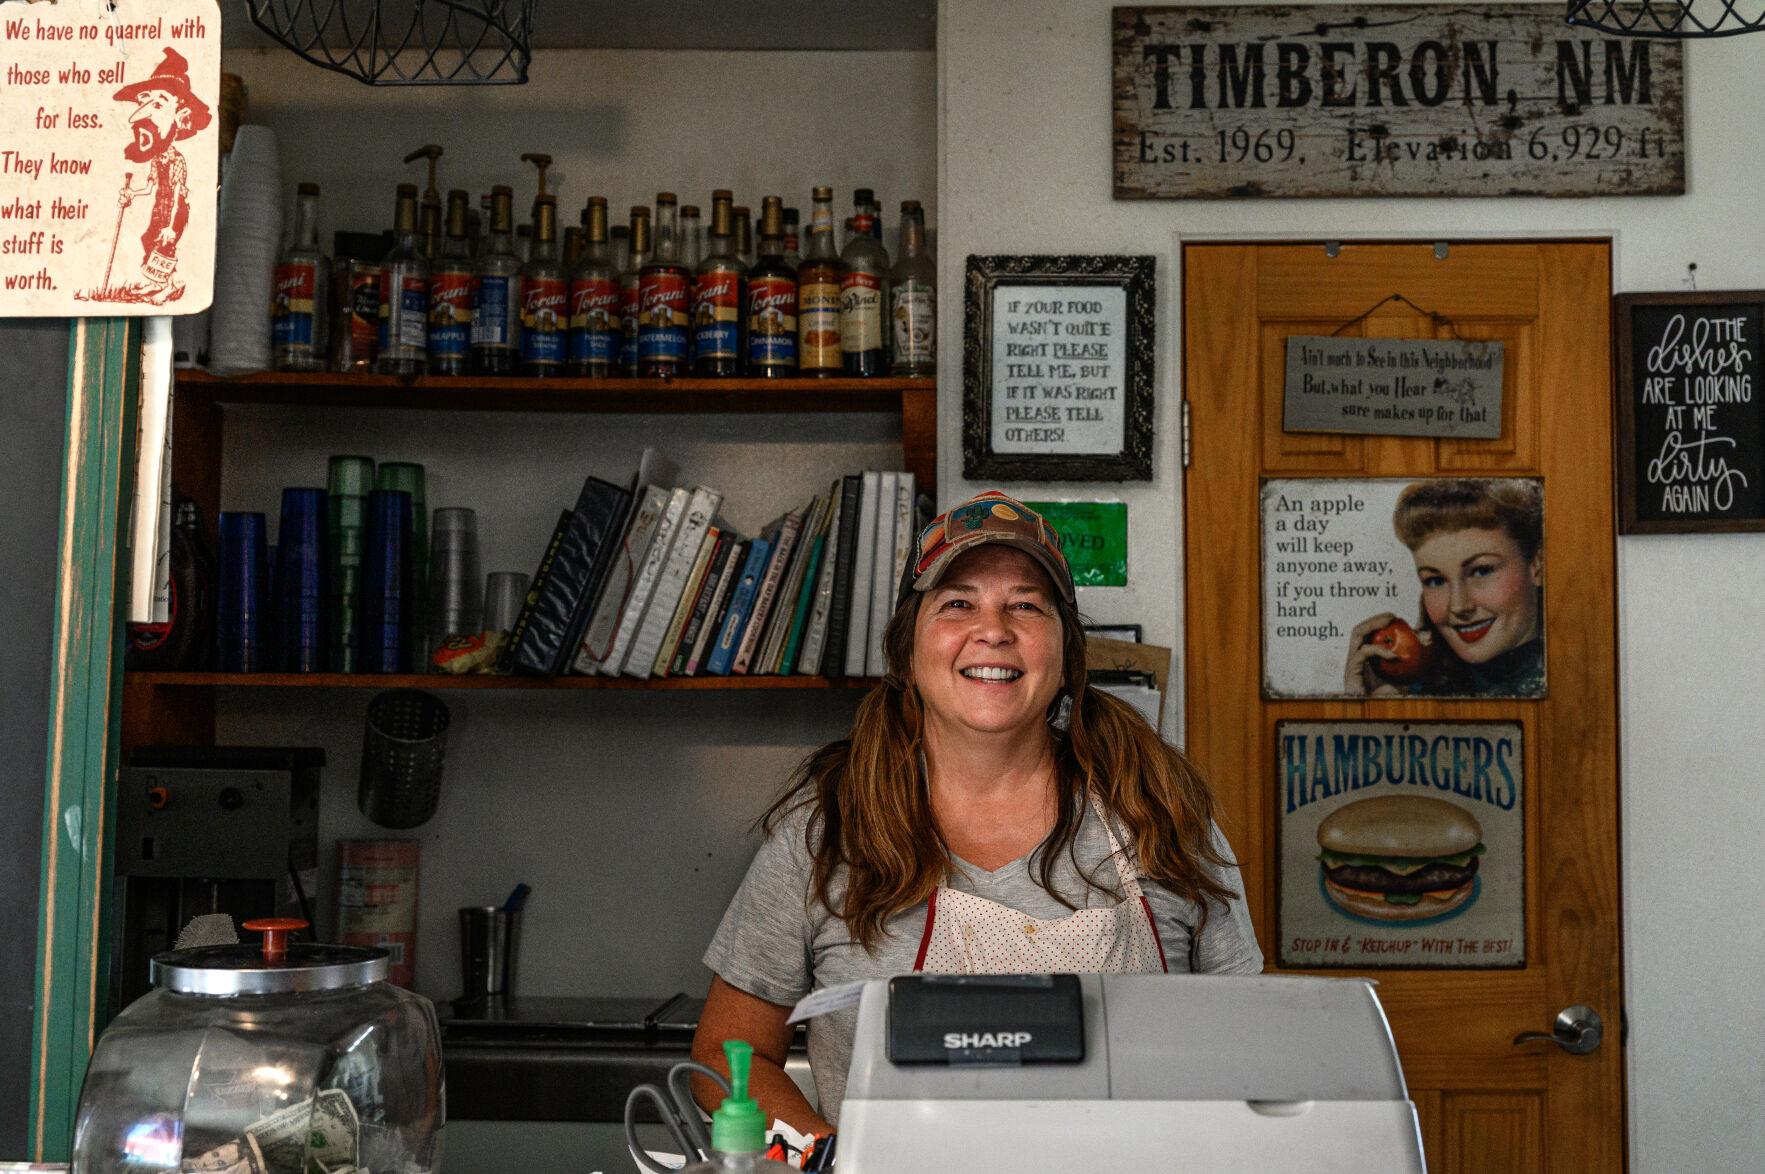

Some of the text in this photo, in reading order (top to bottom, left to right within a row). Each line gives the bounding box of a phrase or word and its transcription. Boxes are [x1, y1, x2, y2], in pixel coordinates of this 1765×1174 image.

[5, 16, 205, 46] We have no quarrel with
[7, 61, 125, 85] those who sell
[1143, 39, 1655, 112] TIMBERON, NM
[36, 107, 103, 130] for less.
[1138, 131, 1202, 164] Est.
[1528, 126, 1623, 163] 6,929
[1, 150, 92, 180] They know
[1, 196, 89, 220] what their
[2, 231, 63, 255] stuff is
[144, 264, 170, 282] WATER
[151, 255, 172, 271] FIRE
[5, 267, 58, 290] worth.
[525, 287, 567, 316] Torani
[640, 284, 686, 311] Torani
[749, 287, 795, 313] Torani
[1007, 301, 1102, 314] IF YOUR FOOD
[1007, 319, 1111, 337] WASN'T QUITE
[1710, 317, 1747, 342] THE
[1007, 343, 1108, 359] RIGHT PLEASE
[1647, 314, 1752, 376] dishes
[1007, 364, 1111, 379] TELL ME, BUT
[1327, 350, 1351, 368] much
[1356, 352, 1366, 368] to
[1367, 346, 1385, 368] See
[1386, 351, 1397, 368] in
[1400, 351, 1420, 369] this
[1422, 348, 1493, 374] Neighborhood
[1006, 386, 1117, 400] IF IT WAS RIGHT
[1368, 381, 1390, 400] you
[1394, 376, 1427, 397] Hear
[1642, 374, 1752, 405] ARE LOOKING
[1005, 407, 1104, 422] PLEASE TELL
[1342, 404, 1487, 425] sure makes up for that
[1665, 405, 1717, 430] AT ME
[1005, 427, 1065, 443] OTHERS!
[1647, 430, 1748, 511] dirty
[1275, 494, 1365, 515] An apple
[1662, 484, 1710, 513] AGAIN
[1275, 515, 1330, 535] a day
[1276, 538, 1354, 556] will keep
[1276, 560, 1393, 576] anyone away,
[1276, 581, 1399, 601] if you throw it
[1276, 601, 1317, 617] hard
[1276, 621, 1344, 640] enough.
[1284, 734, 1516, 814] HAMBURGERS
[1292, 938, 1321, 952] STOP
[1325, 938, 1338, 952] IN
[1422, 938, 1453, 953] WITH
[1455, 938, 1479, 953] THE
[1483, 938, 1513, 953] BEST!
[944, 1031, 1032, 1049] SHARP
